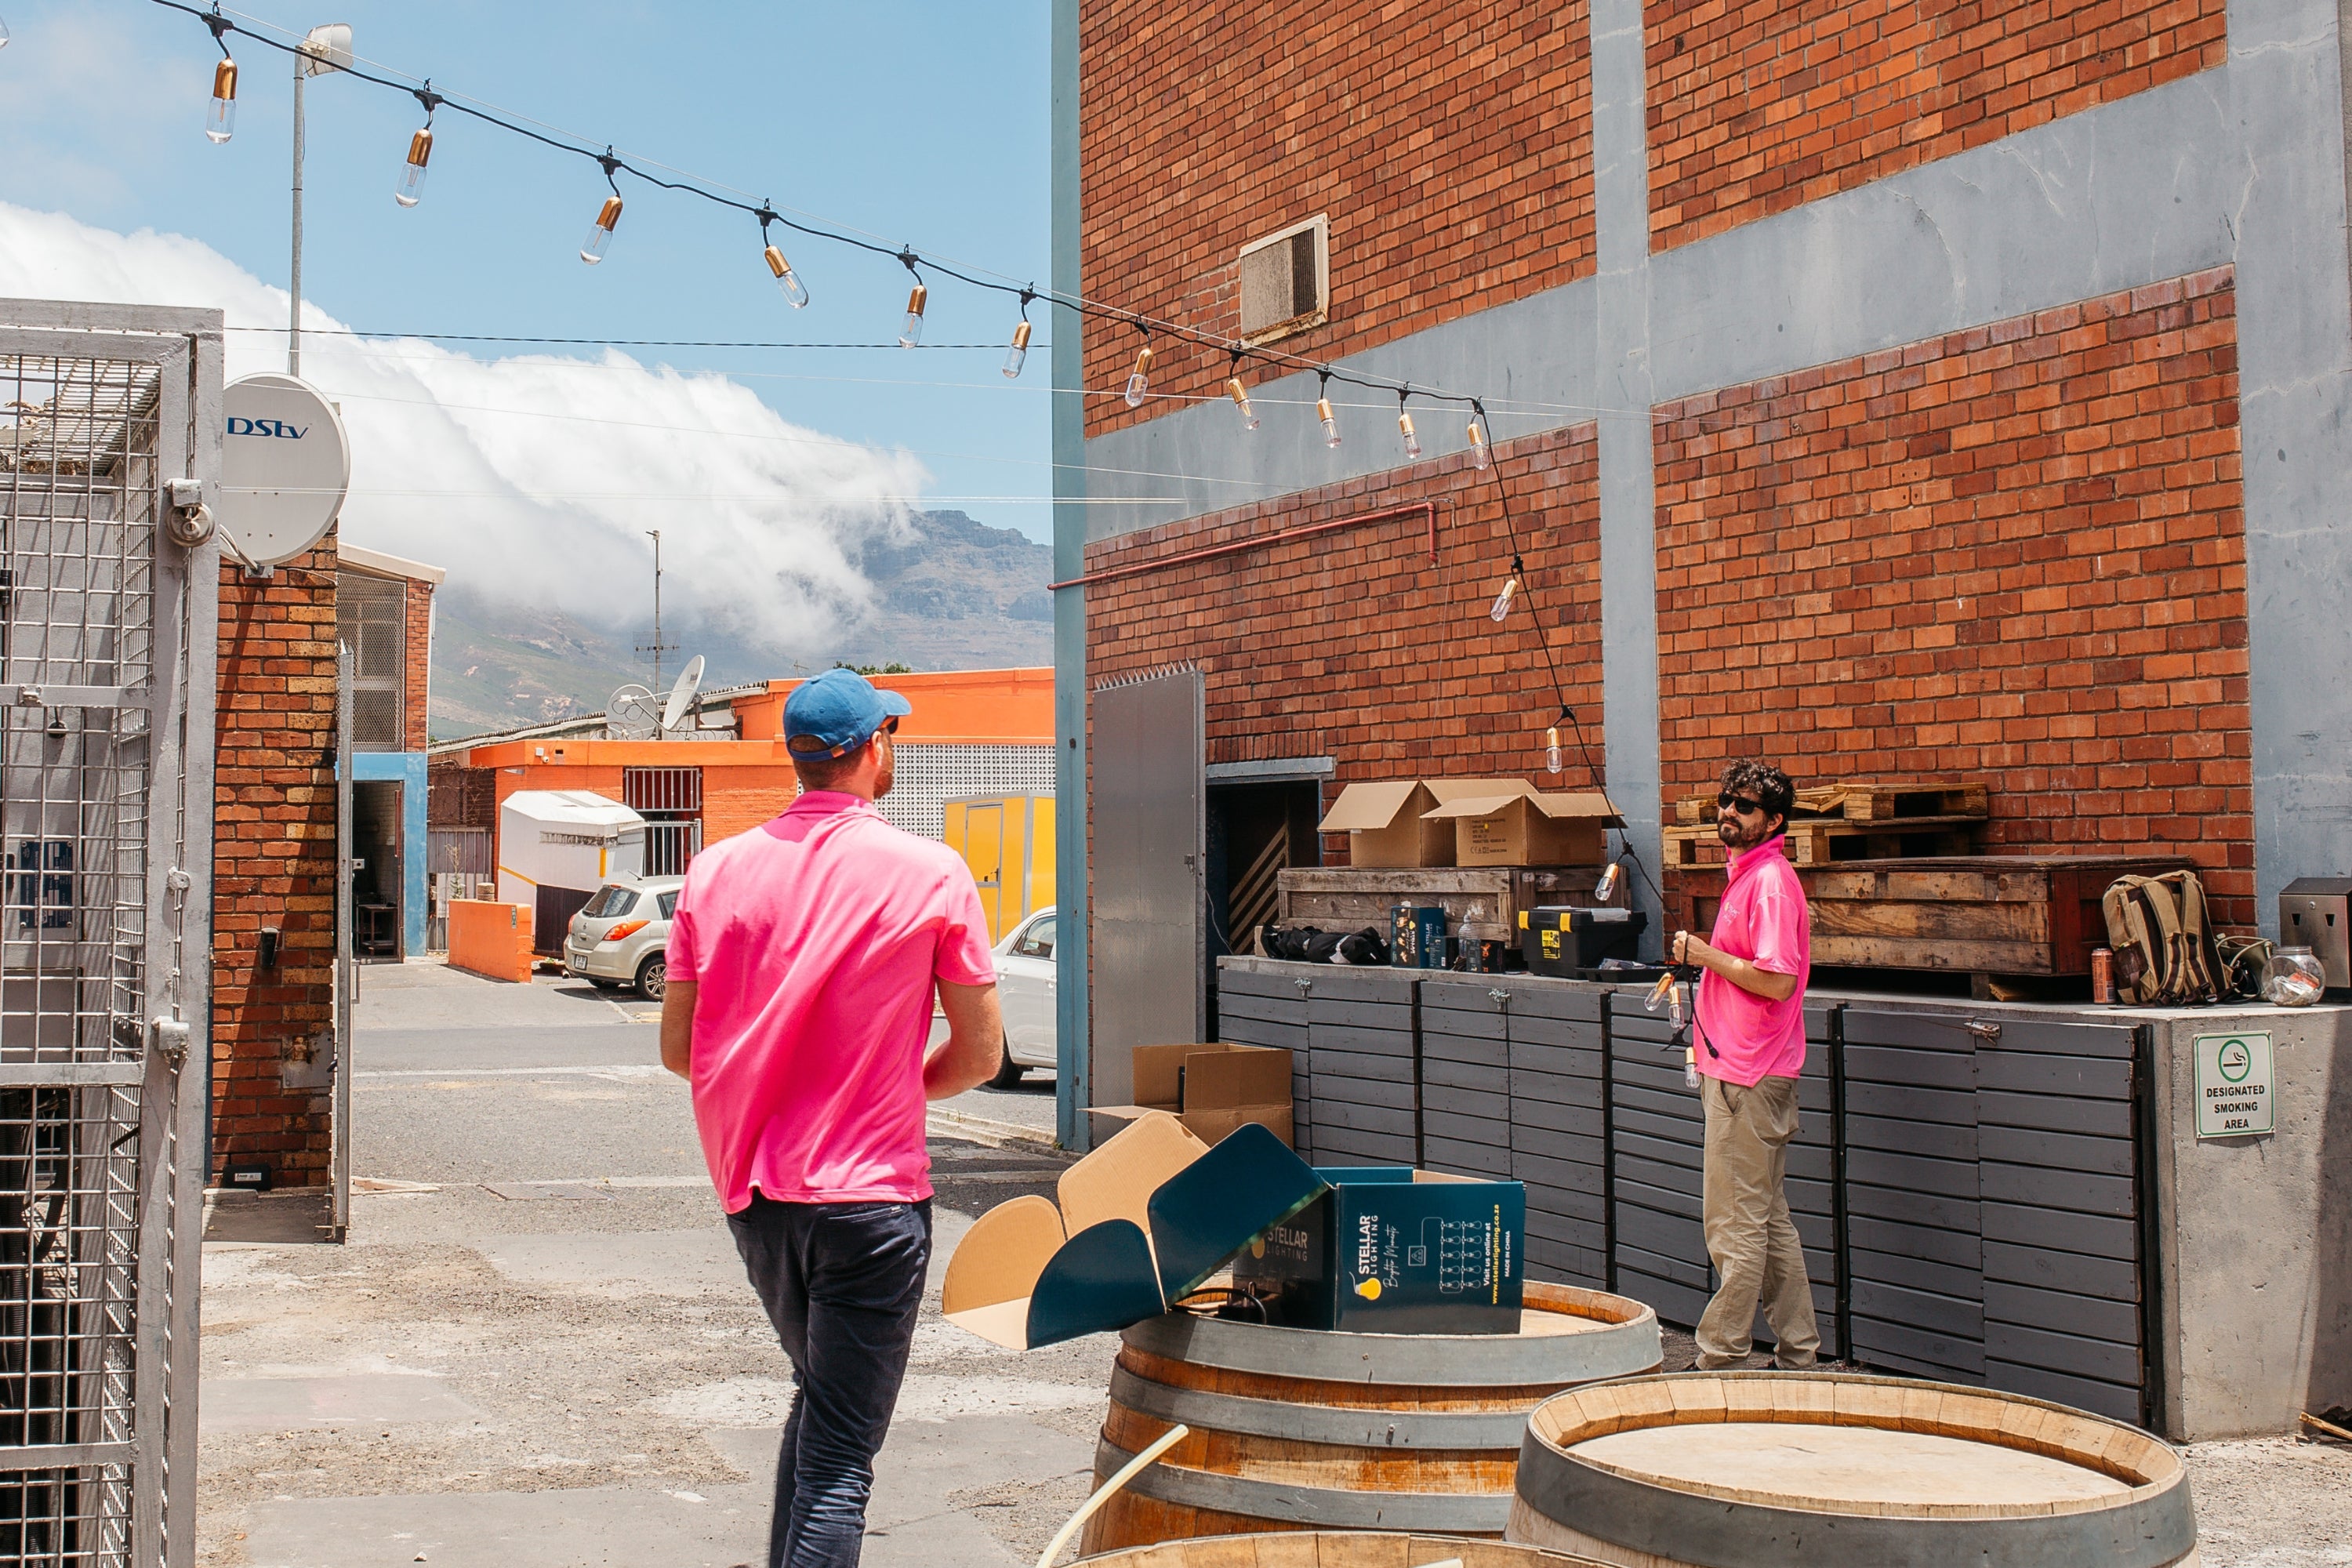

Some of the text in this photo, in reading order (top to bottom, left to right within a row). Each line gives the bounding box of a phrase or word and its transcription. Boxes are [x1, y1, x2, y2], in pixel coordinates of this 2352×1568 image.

[227, 416, 309, 439] DStv
[2206, 1085, 2265, 1098] DESIGNATED
[2214, 1102, 2258, 1113] SMOKING
[2224, 1119, 2249, 1129] AREA
[1485, 1222, 1491, 1231] at
[1268, 1226, 1308, 1249] STELLAR
[1359, 1215, 1370, 1275] STELLAR
[1383, 1224, 1399, 1258] Moments
[1267, 1242, 1308, 1261] LIGHTING
[1492, 1204, 1501, 1305] www.stellarlighting.co.za
[1485, 1258, 1490, 1267] us
